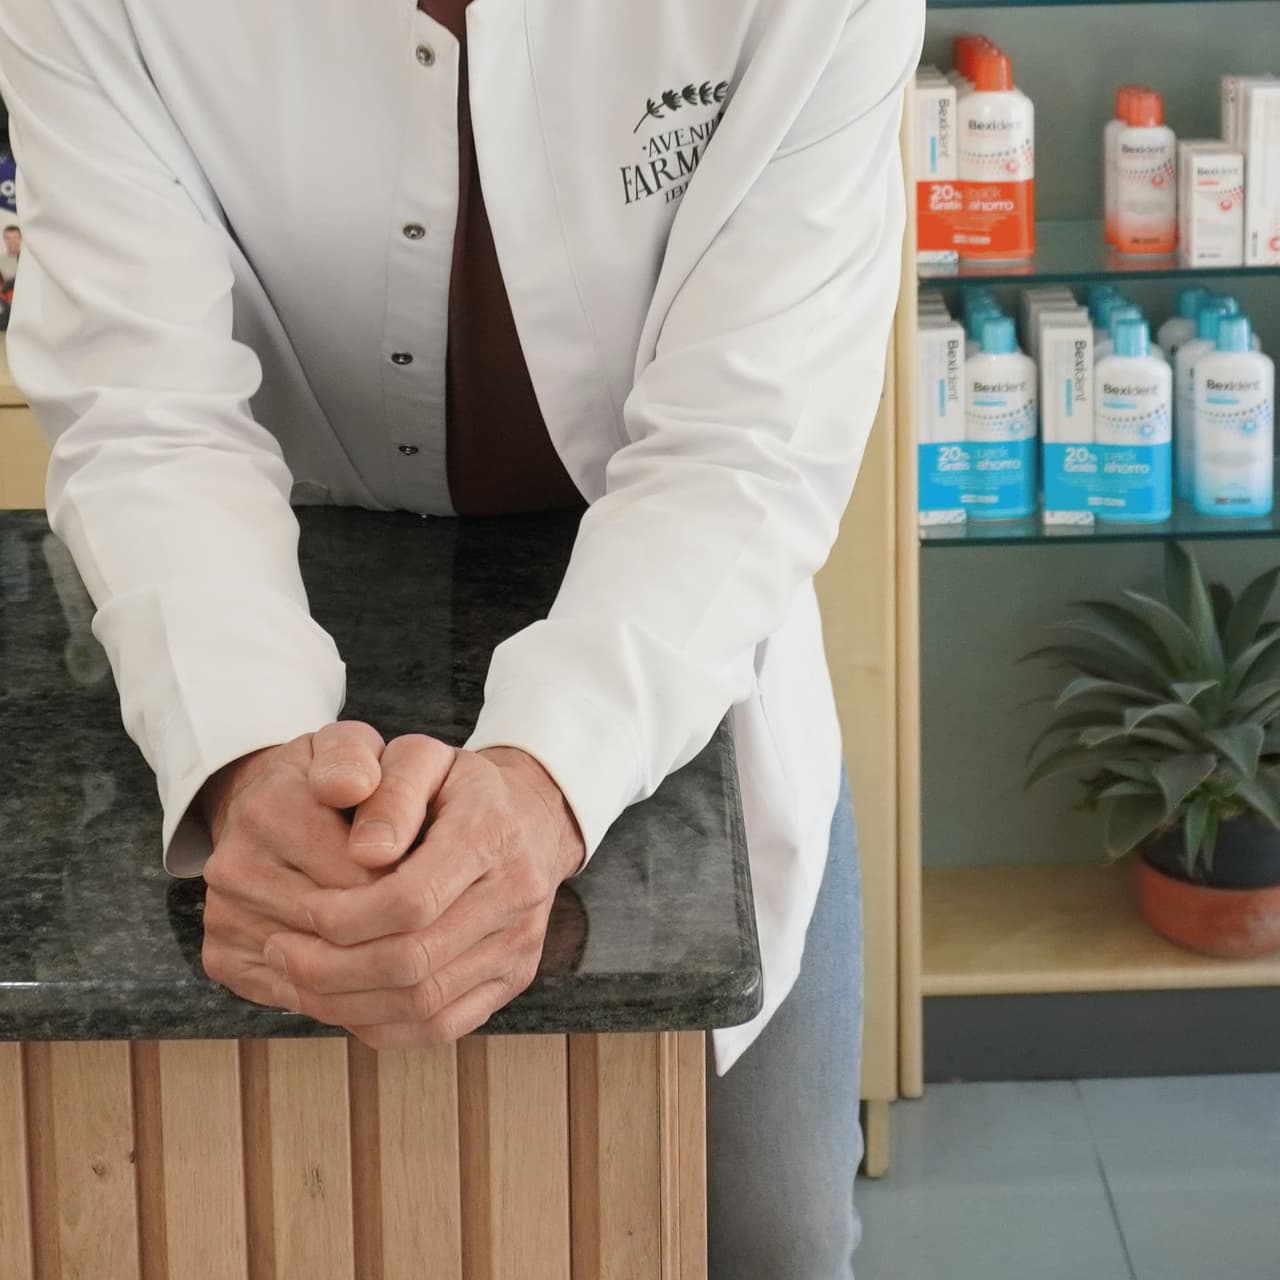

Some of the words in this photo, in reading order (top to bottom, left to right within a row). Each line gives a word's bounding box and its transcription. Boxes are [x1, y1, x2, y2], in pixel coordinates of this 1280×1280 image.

[649, 118, 722, 158] AVENI
[620, 145, 700, 205] FARM
[946, 339, 960, 401] Bexident
[1074, 339, 1088, 402] Bexident
[973, 381, 1028, 393] Bexident
[1103, 383, 1158, 396] Bexident
[1206, 378, 1262, 391] Bexident
[976, 458, 1021, 471] ahorro
[1104, 462, 1151, 475] ahorro
